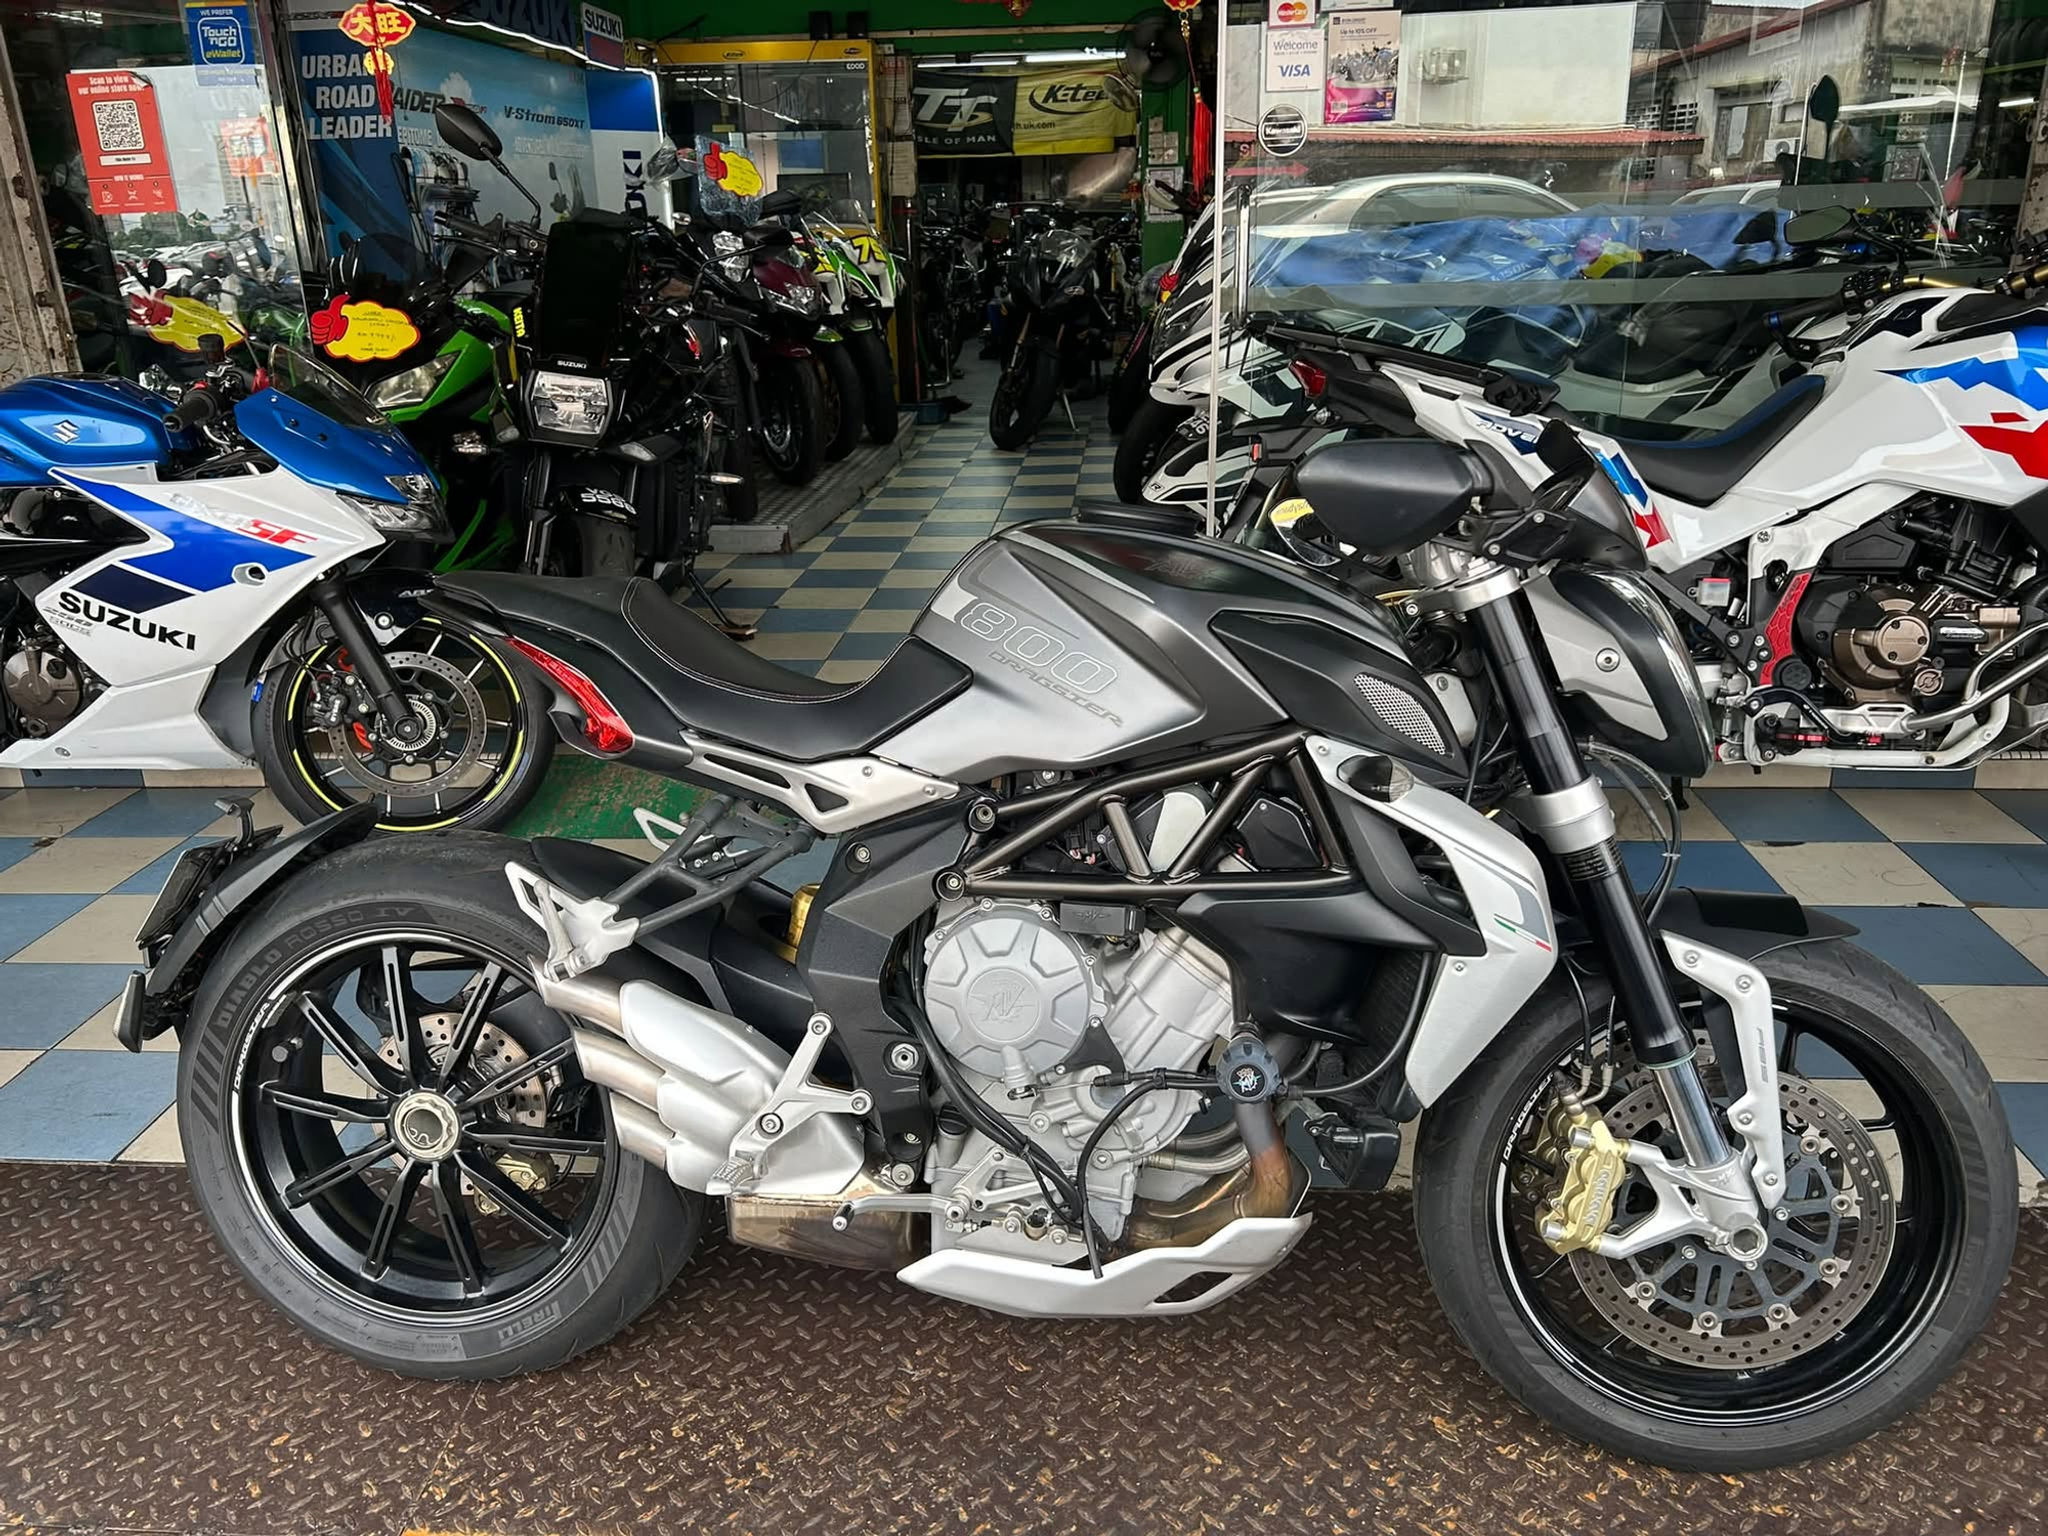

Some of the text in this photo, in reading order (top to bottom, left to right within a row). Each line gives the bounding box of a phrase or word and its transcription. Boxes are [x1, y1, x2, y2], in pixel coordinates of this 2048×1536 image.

[201, 26, 237, 37] Touch
[585, 9, 622, 39] SUZUKI
[205, 49, 241, 58] eWallet
[1273, 40, 1318, 50] Welcome
[302, 54, 370, 78] URBA
[1279, 64, 1310, 77] VISA
[88, 76, 104, 85] Scan
[316, 85, 375, 109] ROAD
[309, 115, 392, 139] LEADER
[1265, 125, 1300, 135] Kawasaki
[944, 135, 961, 145] OF
[966, 135, 997, 143] MAN
[557, 360, 588, 370] SUZUKI
[237, 519, 318, 545] SF
[58, 591, 196, 651] SUZUKI
[960, 602, 1118, 694] 800
[988, 651, 1124, 727] DRAGSTER
[216, 907, 414, 1029] DIABLO ROSSO IV
[234, 1001, 271, 1090] DRAGSTER
[1503, 1073, 1554, 1162] DRAGSTER
[497, 1300, 562, 1347] PIRELLI
